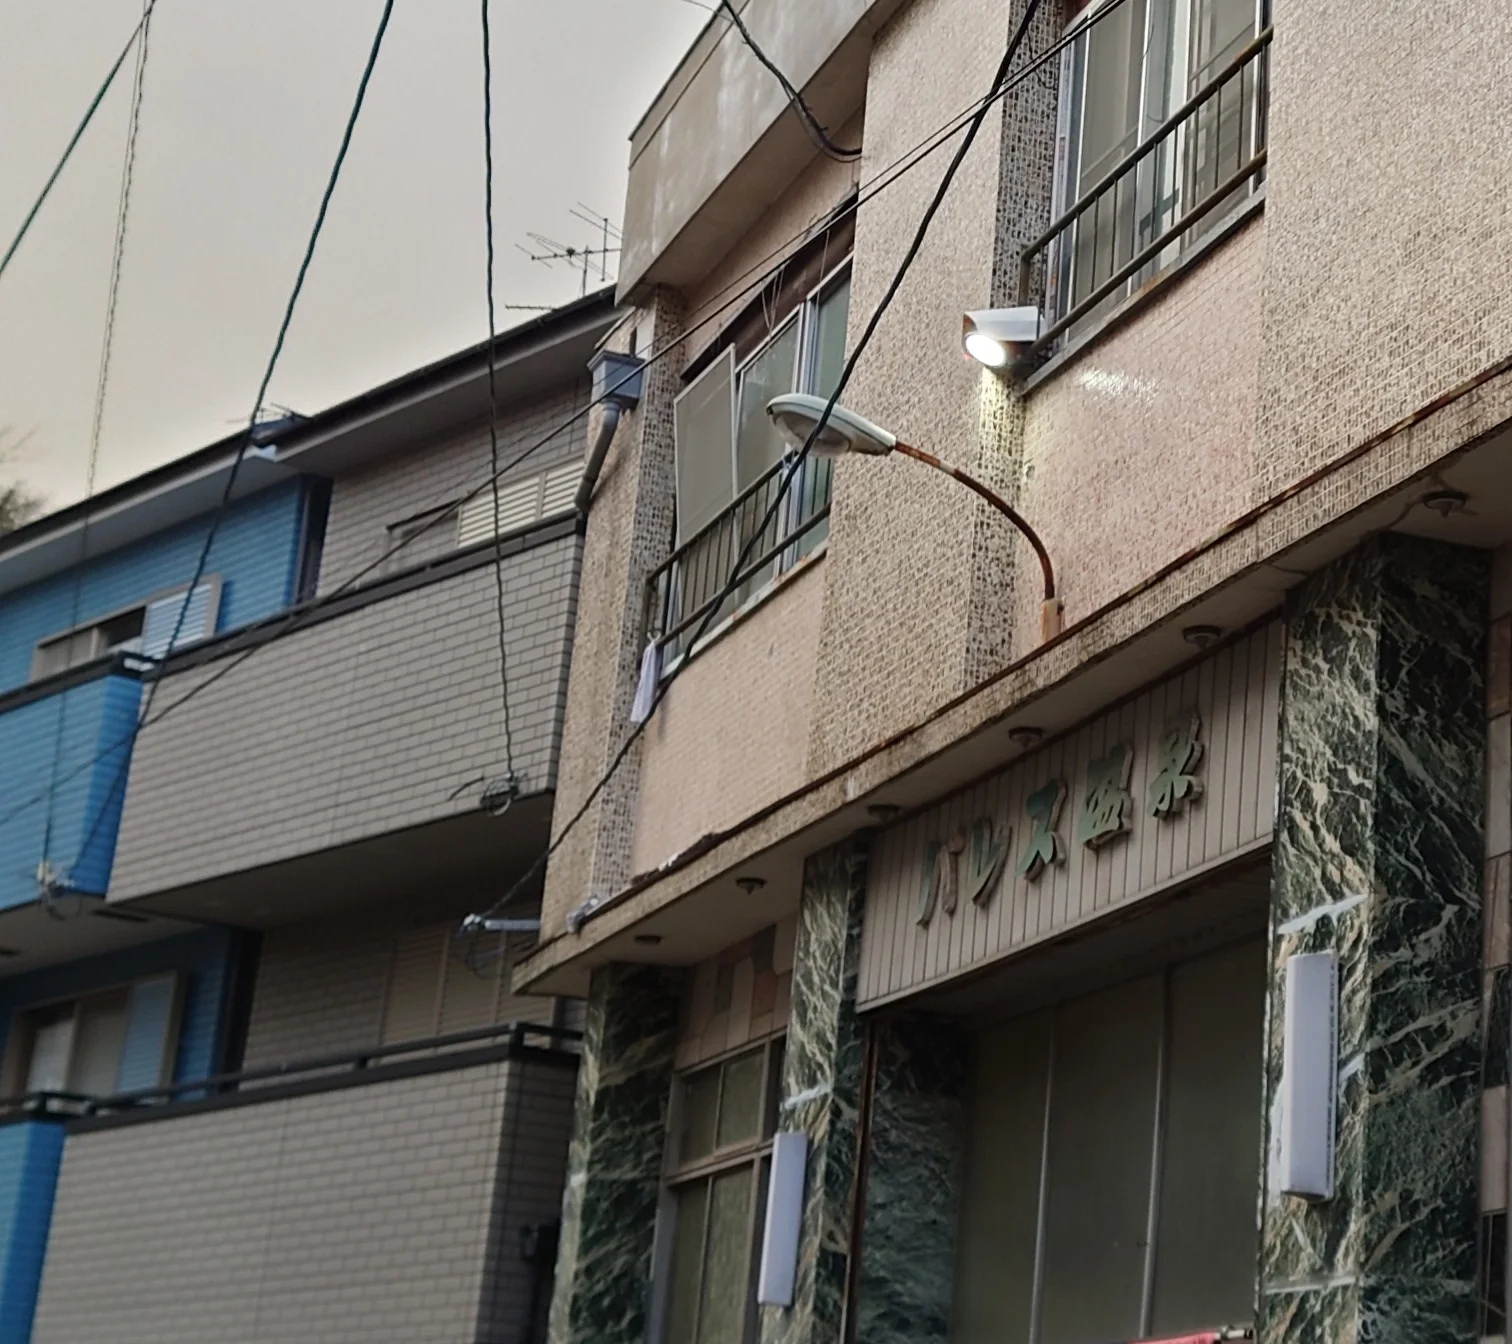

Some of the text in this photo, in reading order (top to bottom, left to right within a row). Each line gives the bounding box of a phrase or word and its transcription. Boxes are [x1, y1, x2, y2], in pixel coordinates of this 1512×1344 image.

[916, 711, 1204, 928] パレス温泉
